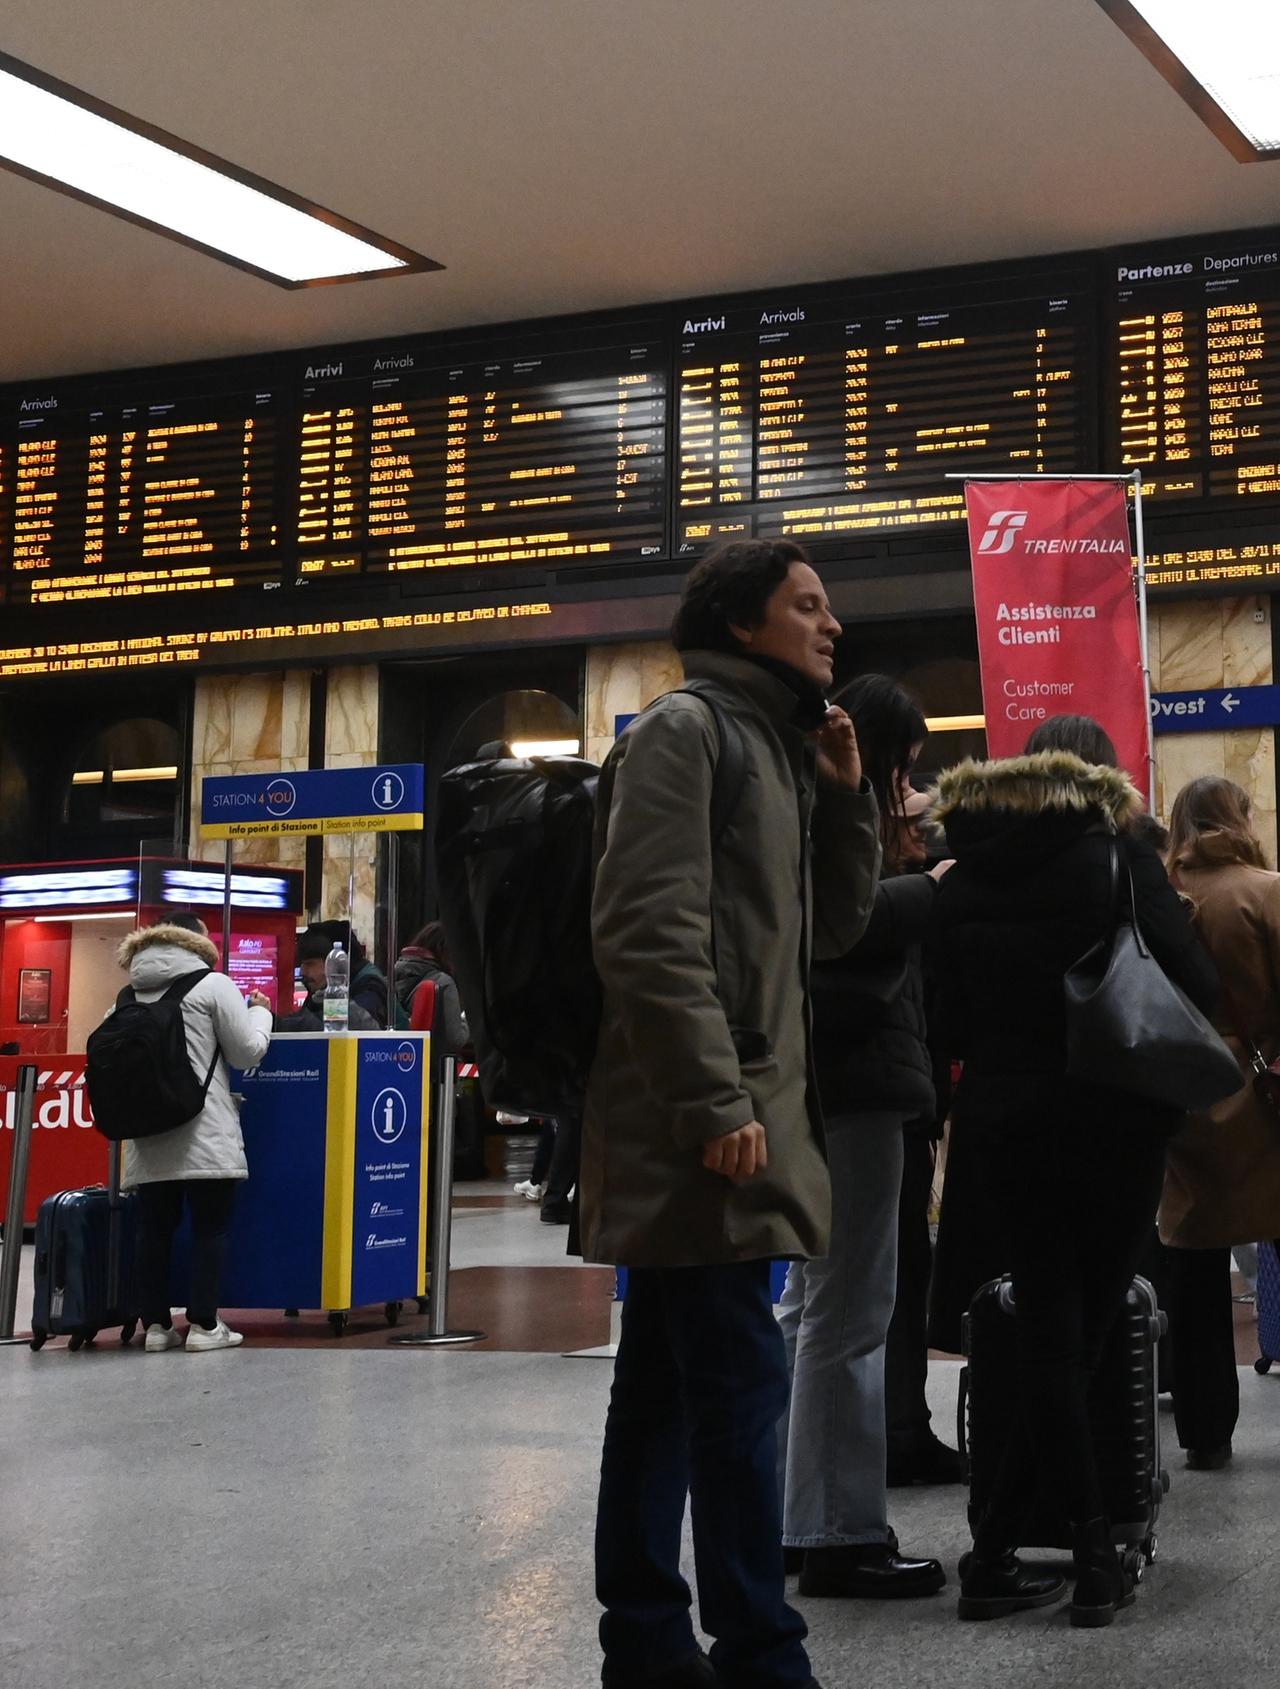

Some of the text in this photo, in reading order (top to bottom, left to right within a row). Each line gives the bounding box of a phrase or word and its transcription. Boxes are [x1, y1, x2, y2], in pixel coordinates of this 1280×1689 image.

[1118, 252, 1278, 282] Partenze Departures
[682, 307, 805, 334] Arrivi Arrivals
[304, 355, 414, 379] Arrivi Arrivals
[20, 397, 58, 411] Arrivals
[1024, 540, 1125, 554] TRENITALIA
[996, 602, 1096, 621] Assistenza
[999, 626, 1060, 645] Clienti
[1003, 680, 1074, 697] Customer
[1006, 703, 1046, 720] Care
[1150, 697, 1206, 717] Ovest
[213, 793, 257, 808] STATION
[268, 791, 292, 804] YOU
[229, 822, 318, 835] Info point di Stazione
[326, 818, 386, 830] Station info point
[365, 1052, 393, 1063] STATION
